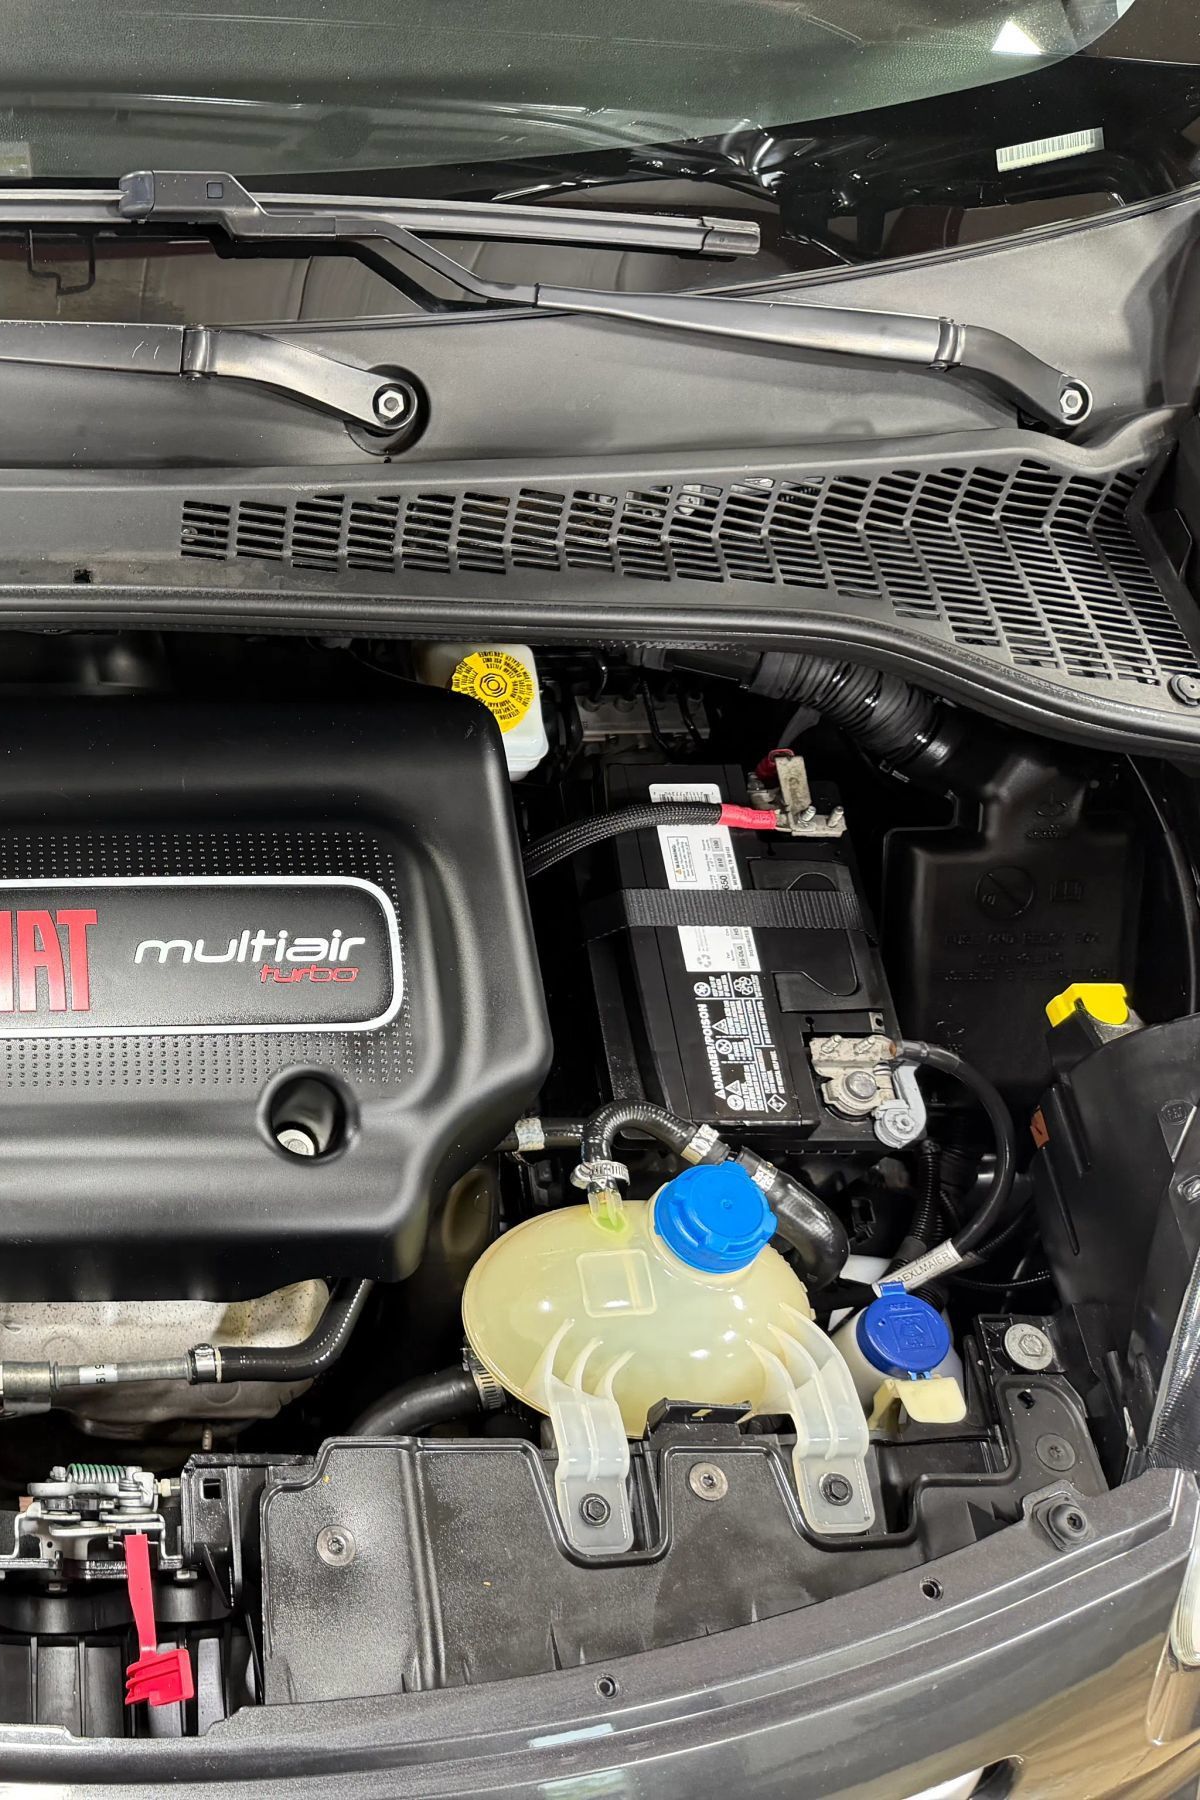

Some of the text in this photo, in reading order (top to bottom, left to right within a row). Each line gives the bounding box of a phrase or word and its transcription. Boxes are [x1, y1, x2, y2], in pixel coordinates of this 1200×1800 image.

[720, 876, 729, 890] 650
[134, 929, 366, 963] multiair
[259, 964, 359, 984] turbo
[697, 1004, 726, 1089] DANGER/POISON
[894, 1252, 952, 1283] AEXLMAIER
